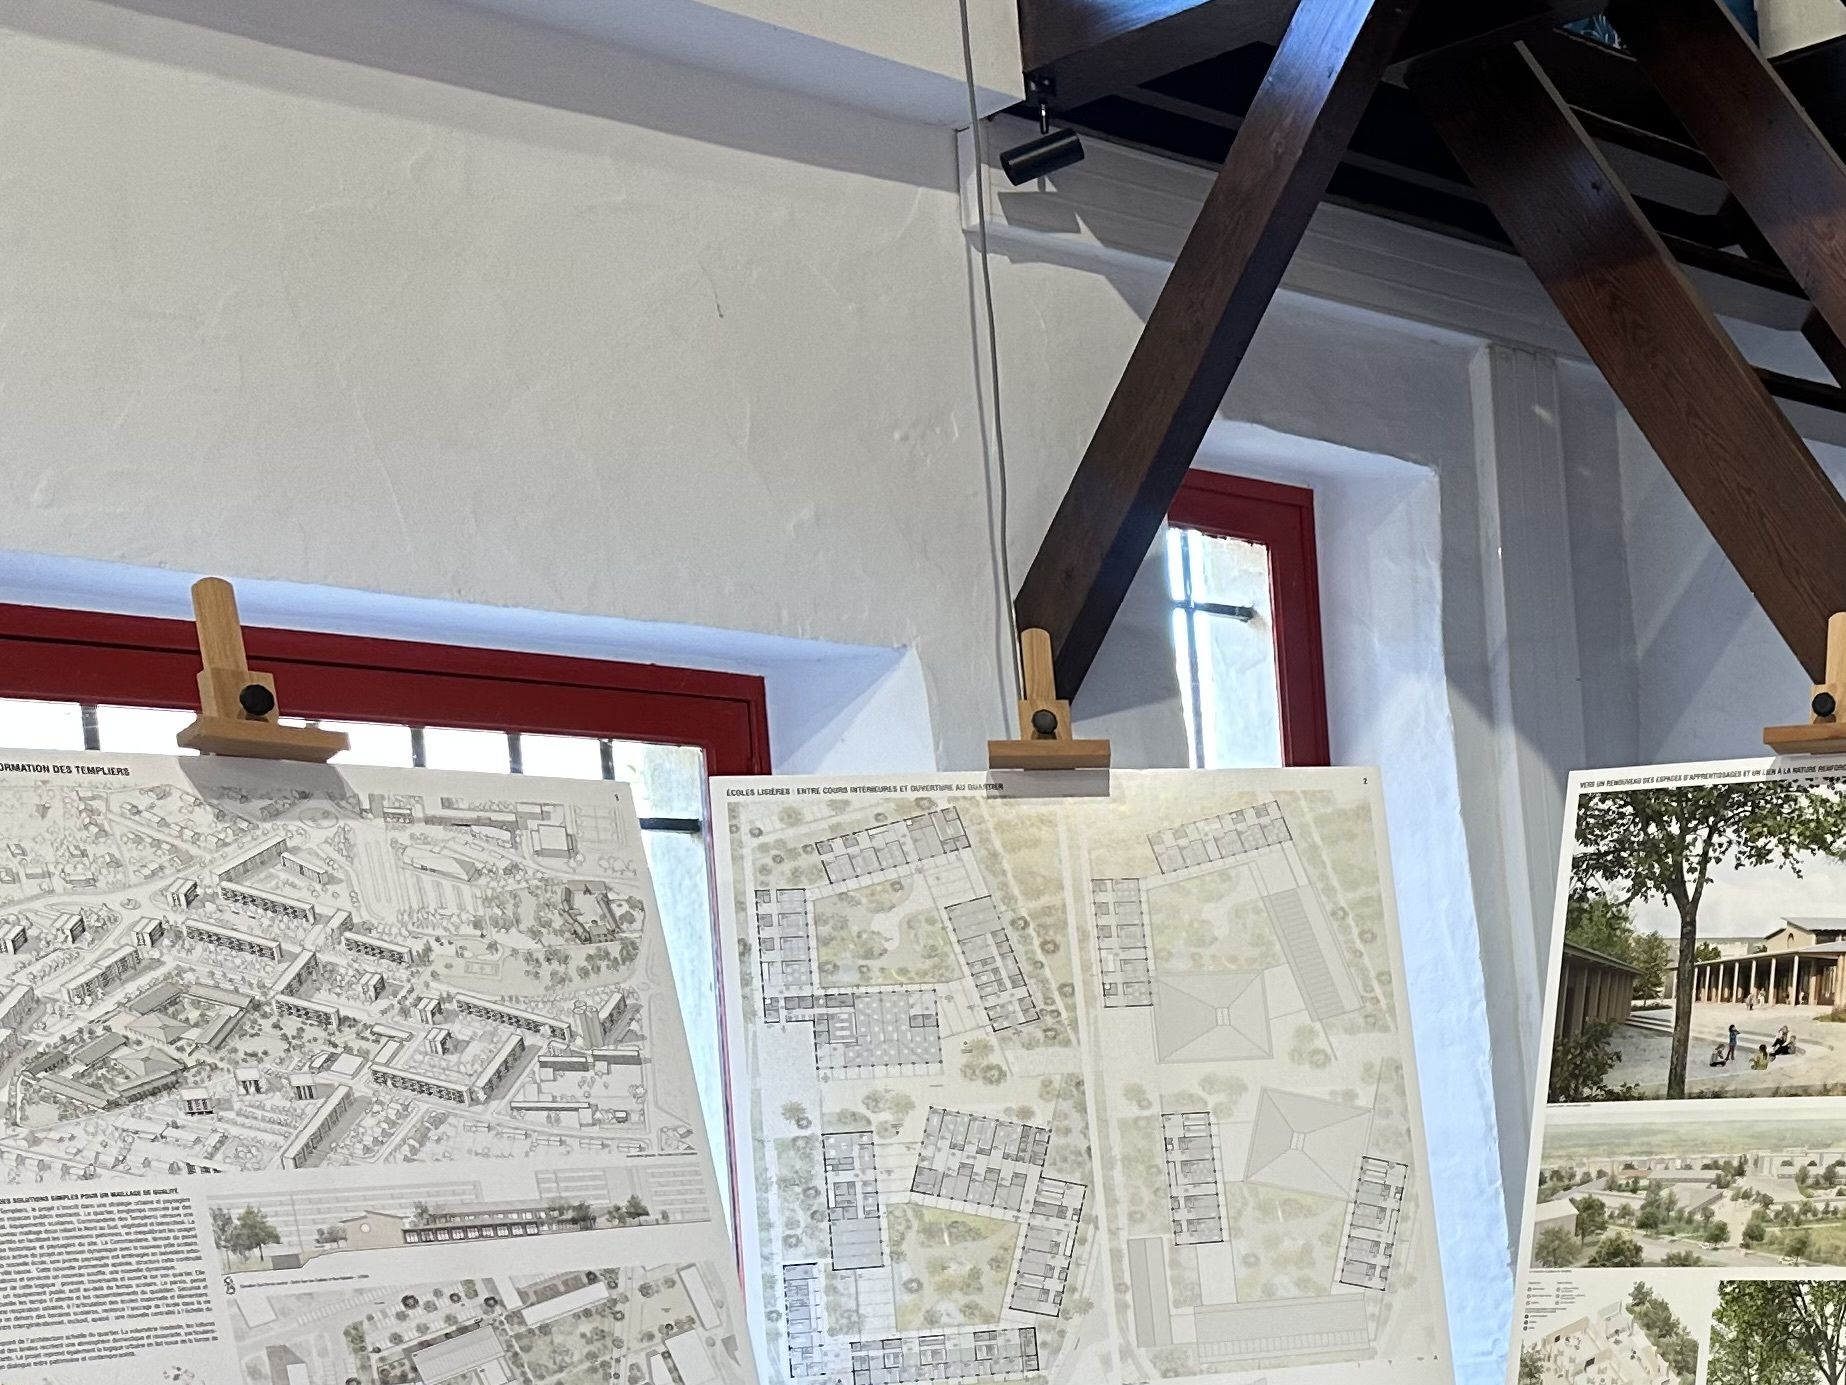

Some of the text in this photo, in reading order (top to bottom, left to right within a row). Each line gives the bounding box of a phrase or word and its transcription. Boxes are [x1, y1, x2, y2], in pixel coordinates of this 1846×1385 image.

[53, 764, 72, 774] DES
[75, 765, 130, 776] TEMPLIERS
[1643, 776, 1654, 784] DES
[726, 788, 756, 796] ÉCOLES
[796, 786, 820, 795] ENTRE
[822, 786, 848, 794] COURS
[900, 784, 908, 792] ET
